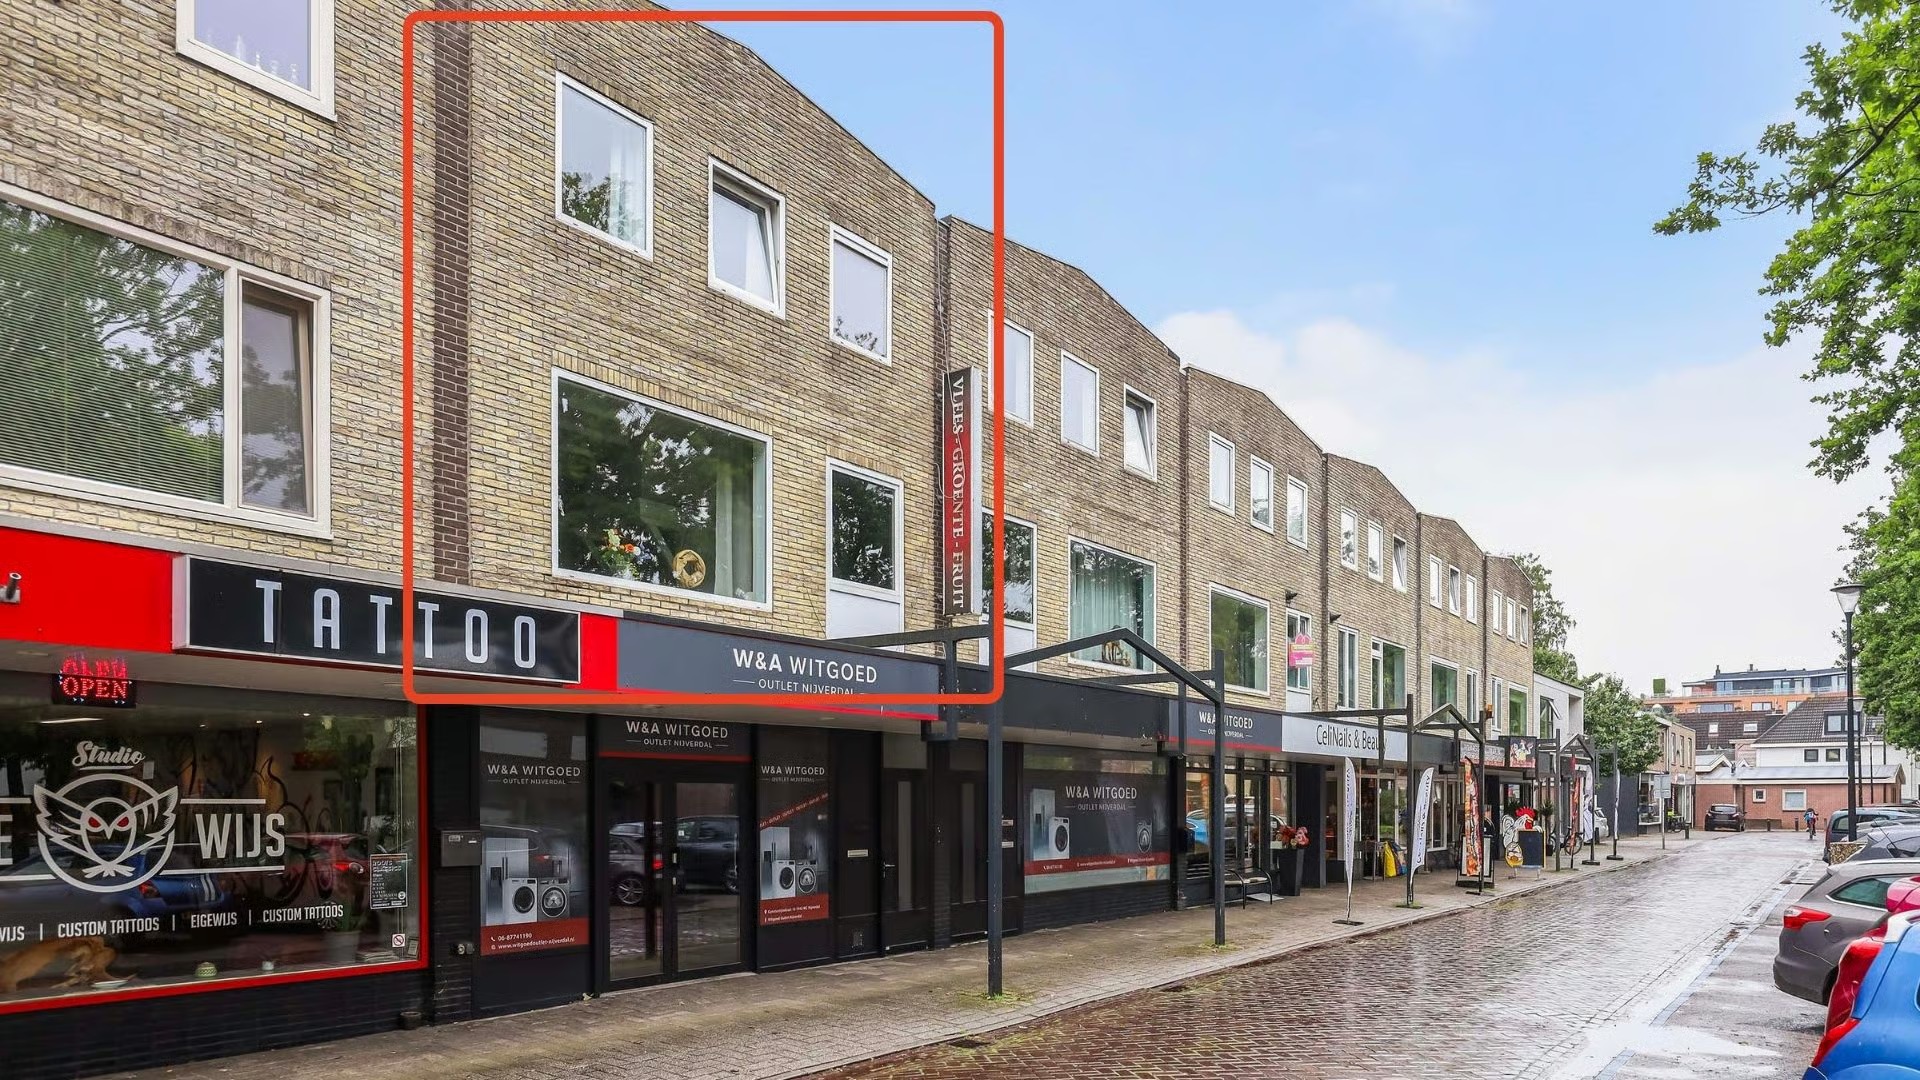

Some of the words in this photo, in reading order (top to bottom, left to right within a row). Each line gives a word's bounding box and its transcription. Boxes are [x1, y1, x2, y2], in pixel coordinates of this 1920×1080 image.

[952, 375, 964, 435] VLEES
[952, 447, 965, 539] GROENTE
[952, 550, 964, 608] FRUIT
[255, 579, 536, 669] TATTOO
[733, 648, 783, 673] W&A
[789, 655, 877, 684] WITGOED
[62, 676, 128, 699] OPEN
[758, 678, 799, 692] OUTLET
[625, 720, 660, 735] W&A
[664, 723, 728, 739] WITGOED
[1223, 713, 1253, 729] ITGOED
[643, 738, 672, 746] OUTLET
[673, 740, 713, 749] NIJVERDAL
[1316, 724, 1352, 748] CeliNails
[1353, 729, 1360, 749] &
[1362, 730, 1387, 752] Beau
[72, 740, 146, 767] Studio
[487, 764, 518, 775] W&A
[522, 765, 581, 777] WITGOED
[761, 765, 783, 775] W&A
[784, 766, 825, 776] WITGOED
[1065, 785, 1090, 799] W&A
[1092, 786, 1138, 799] WITGOED
[195, 813, 285, 859] WIJS
[57, 920, 107, 938] CUSTOM
[110, 917, 160, 934] TATTOOS
[190, 912, 238, 928] EIGEWIJS
[262, 908, 302, 923] CUSTOM
[303, 904, 344, 919] TATTOOS
